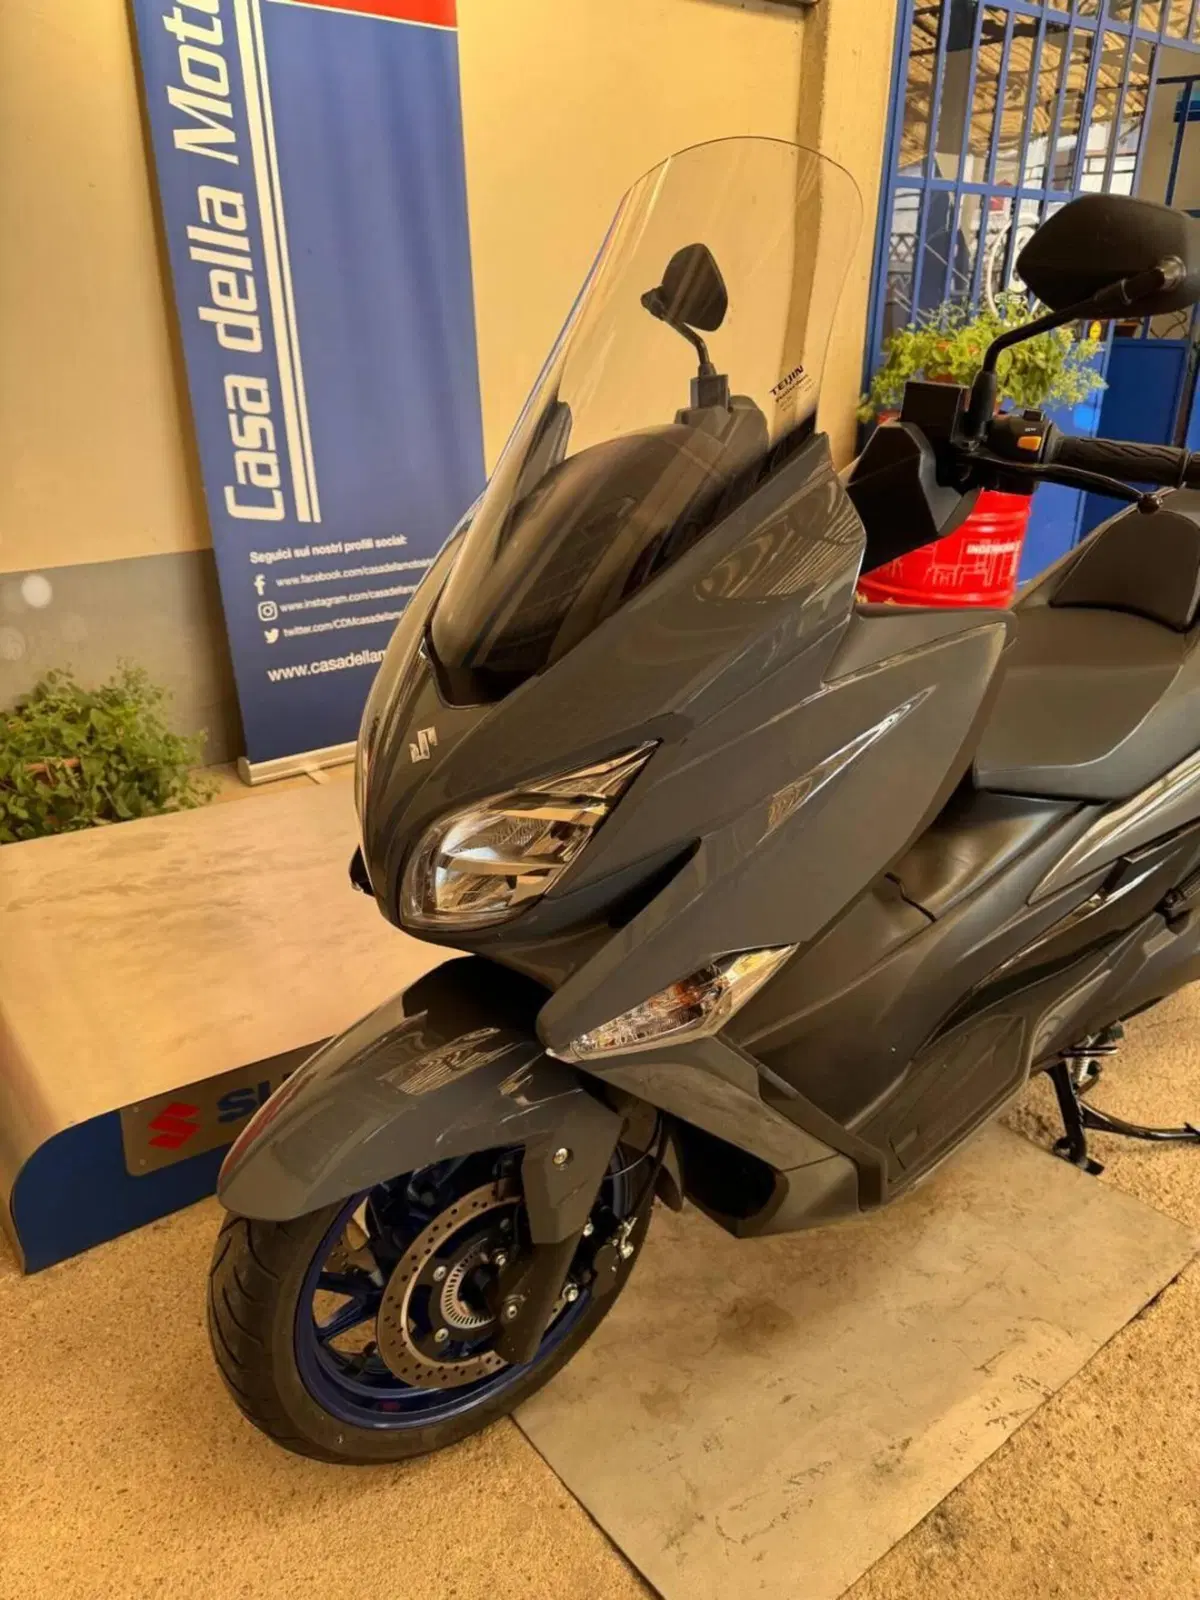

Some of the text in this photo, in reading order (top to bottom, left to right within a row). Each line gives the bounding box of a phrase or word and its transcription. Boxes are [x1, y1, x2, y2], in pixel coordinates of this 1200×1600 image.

[162, 0, 286, 523] Casa della Mot
[769, 365, 804, 395] TEIJIN
[250, 547, 292, 564] Seguici
[294, 545, 310, 558] sui
[312, 541, 342, 556] nostri
[343, 537, 374, 554] profili
